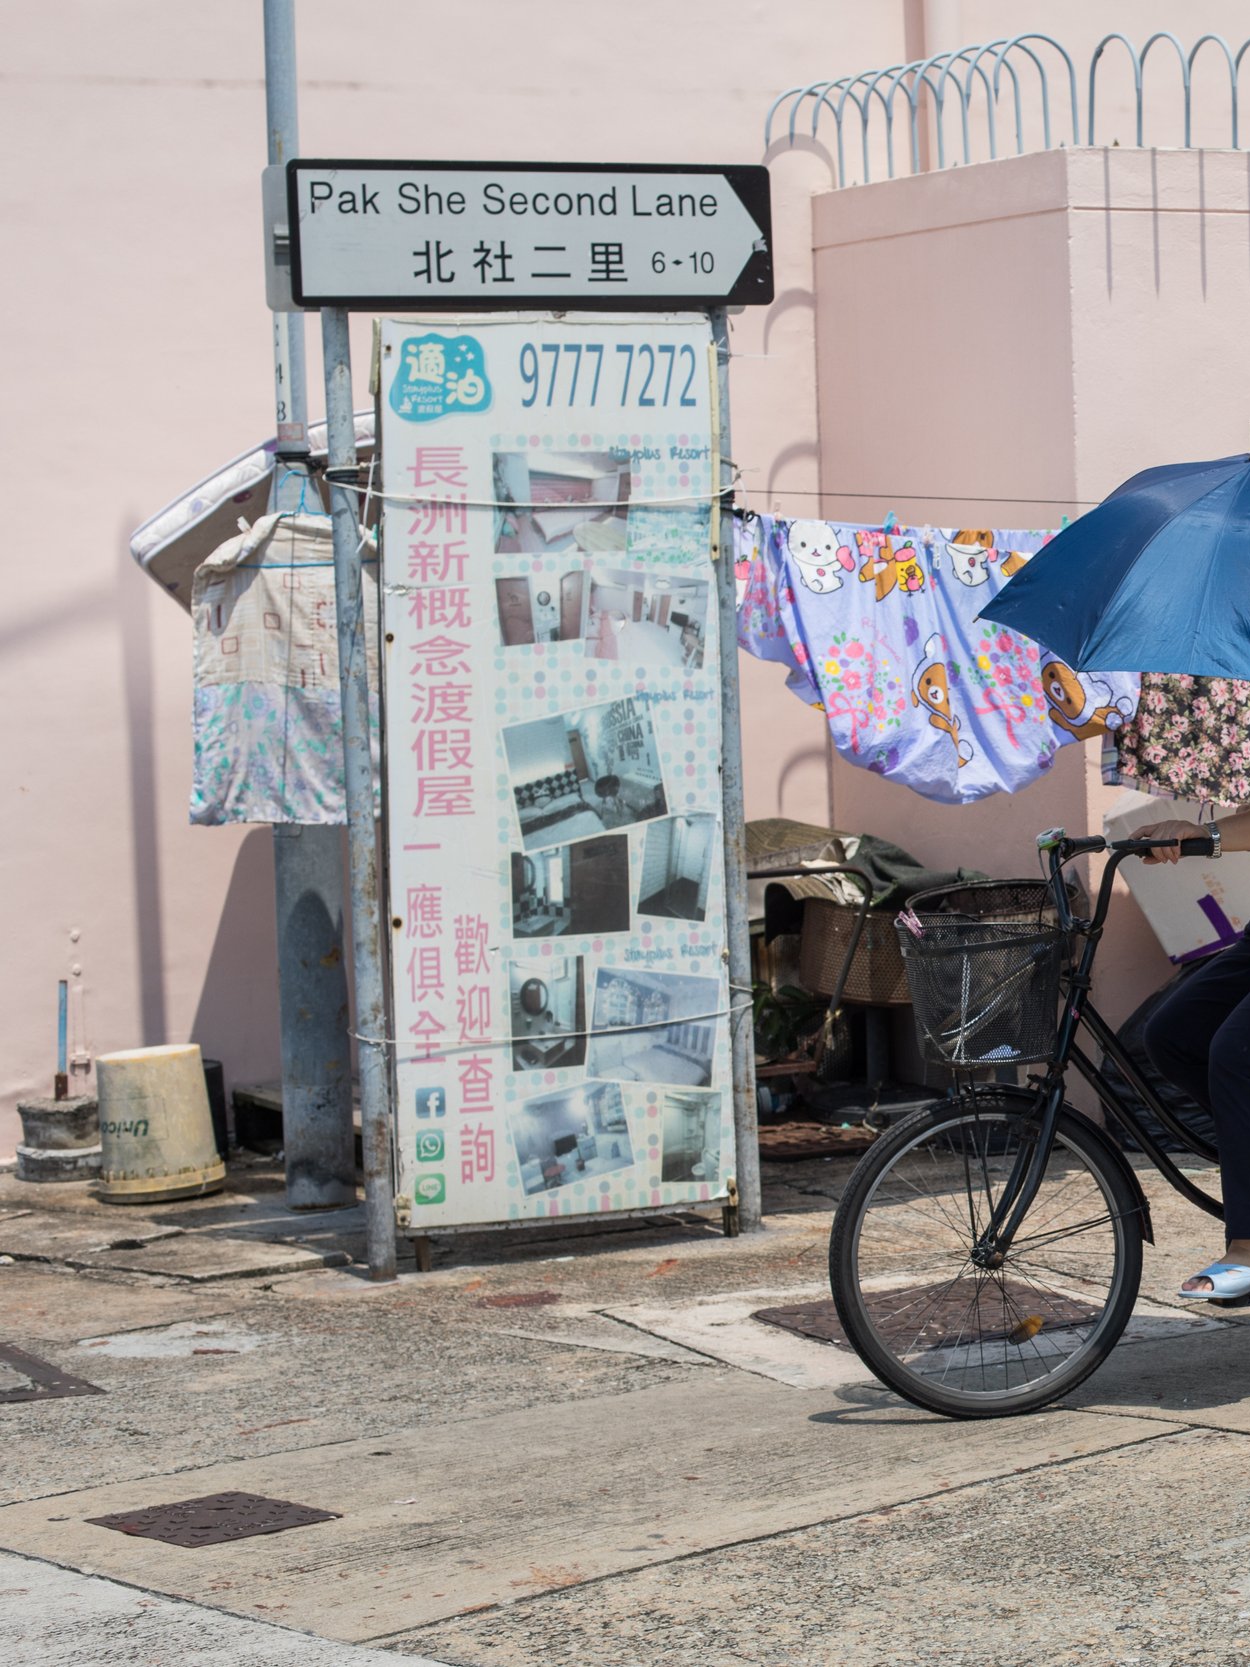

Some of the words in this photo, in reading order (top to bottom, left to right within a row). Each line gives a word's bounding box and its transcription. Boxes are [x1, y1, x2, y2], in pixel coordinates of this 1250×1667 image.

[309, 181, 381, 215] Pak
[397, 182, 467, 216] She
[482, 183, 618, 217] Second
[632, 184, 719, 217] Lane
[412, 240, 629, 284] 北社二里
[519, 342, 604, 408] 9777
[615, 343, 697, 407] 7272
[406, 446, 476, 817] 長洲新概念渡假屋
